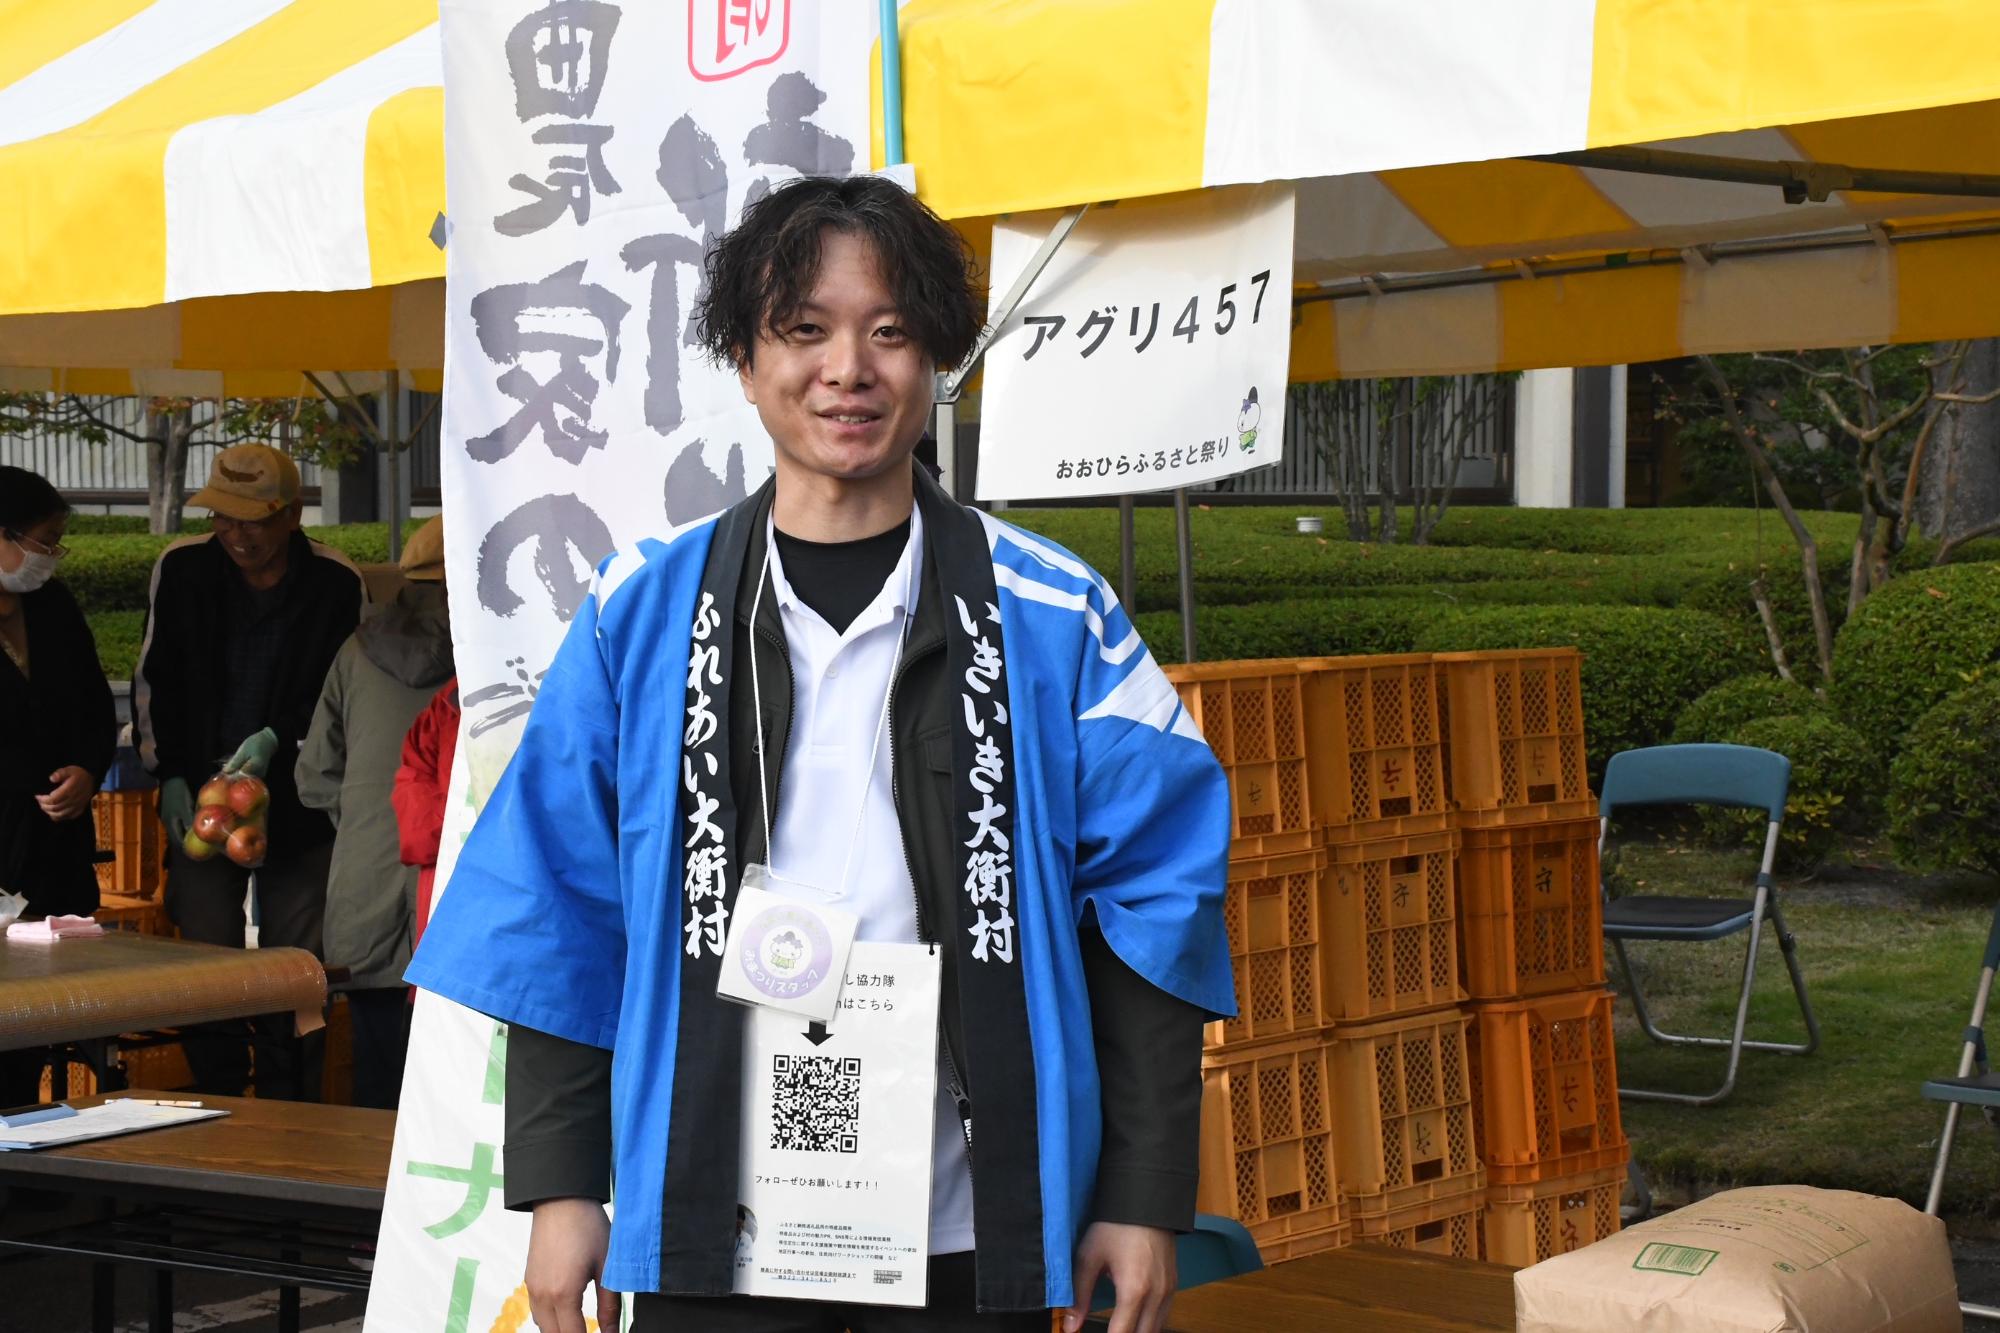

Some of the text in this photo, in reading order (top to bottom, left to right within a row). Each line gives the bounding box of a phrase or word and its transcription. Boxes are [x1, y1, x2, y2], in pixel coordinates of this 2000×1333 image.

[1056, 436, 1230, 480] おおひらふるさと祭り
[683, 591, 730, 960] ふれあい大衡村
[954, 593, 1015, 964] いきいき大衡村
